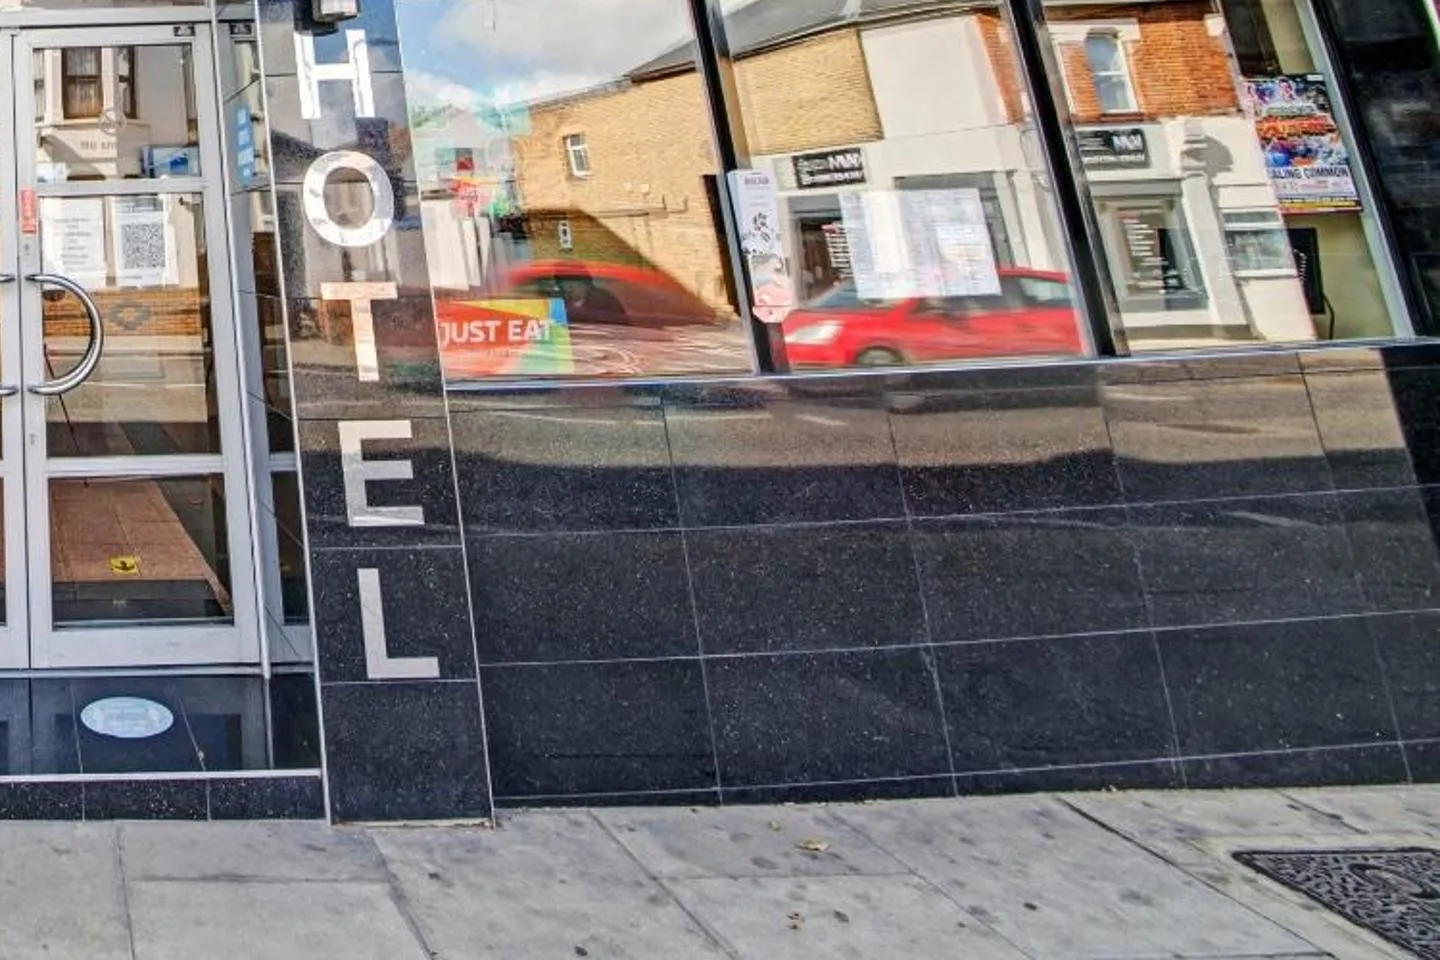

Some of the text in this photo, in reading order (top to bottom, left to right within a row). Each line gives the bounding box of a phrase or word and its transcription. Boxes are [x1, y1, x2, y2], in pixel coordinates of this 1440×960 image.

[293, 28, 441, 679] HOTEL
[439, 318, 552, 349] JUST EAT
